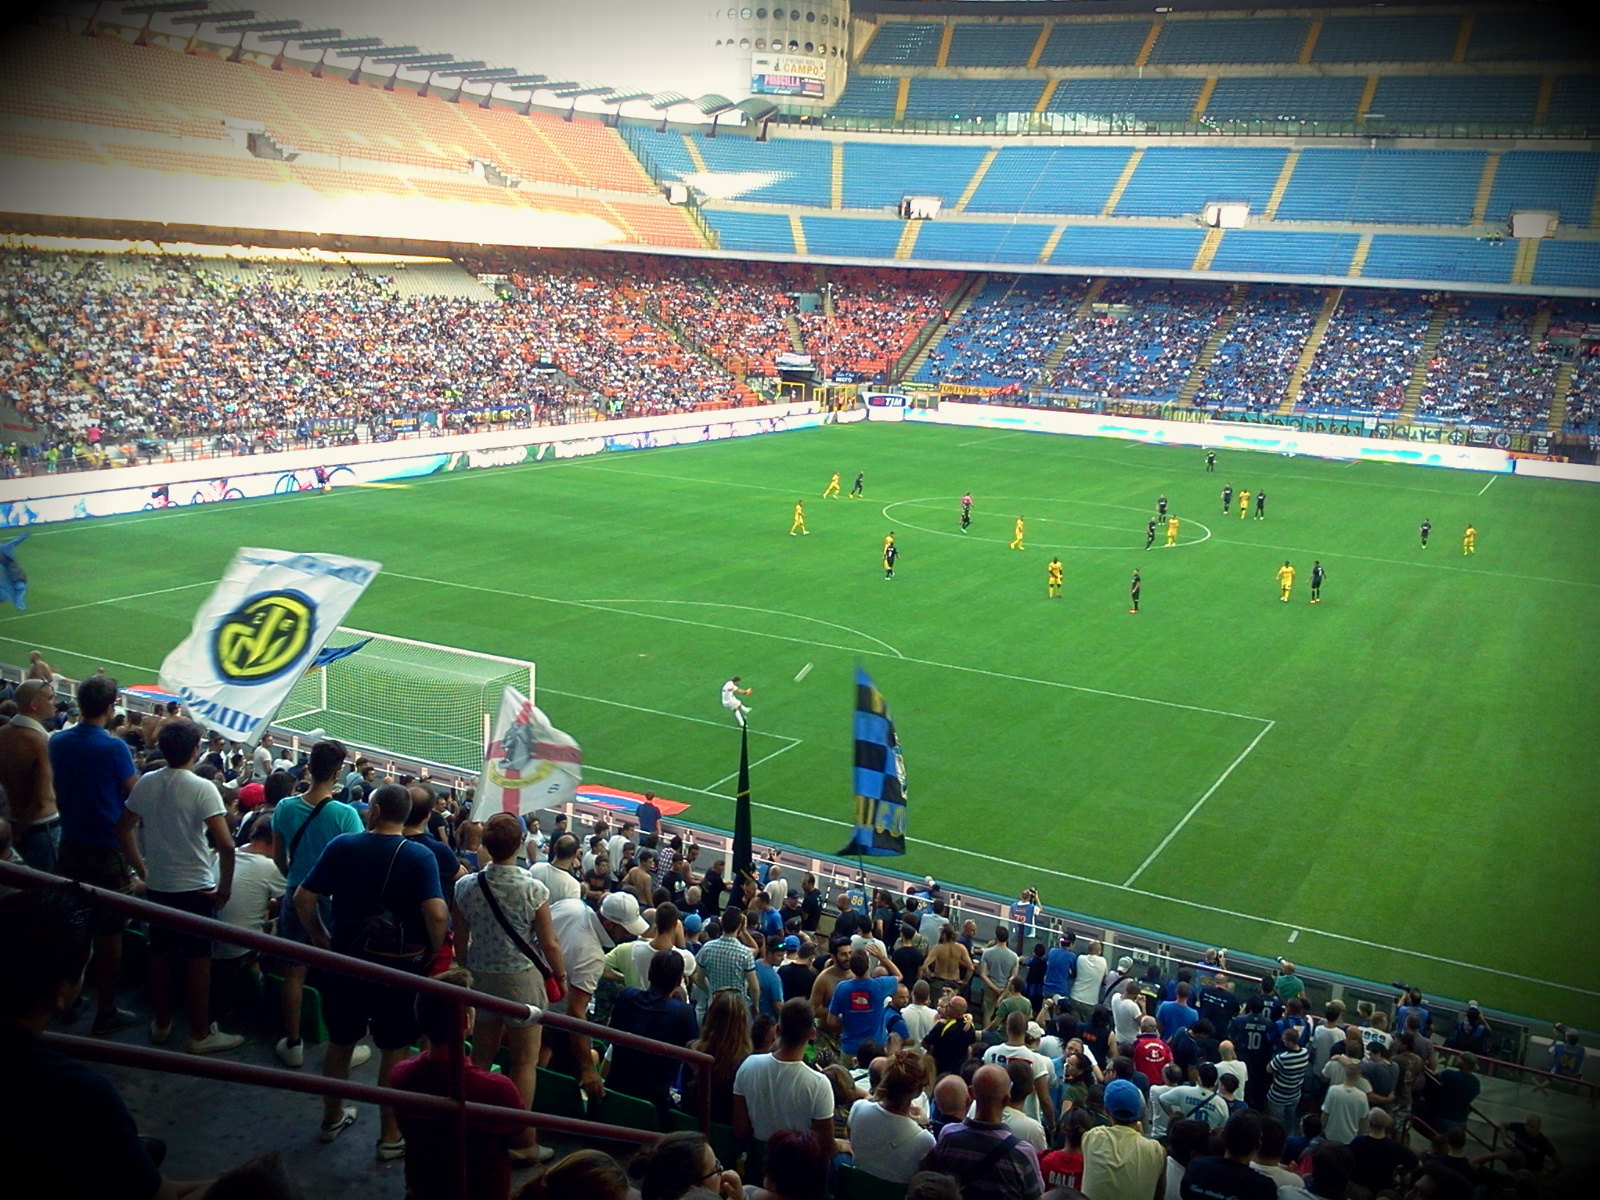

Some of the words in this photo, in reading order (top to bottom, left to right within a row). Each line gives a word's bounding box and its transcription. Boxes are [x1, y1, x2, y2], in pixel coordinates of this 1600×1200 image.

[783, 64, 819, 75] CAMPO
[885, 396, 903, 407] TIM
[1247, 1031, 1262, 1050] 10
